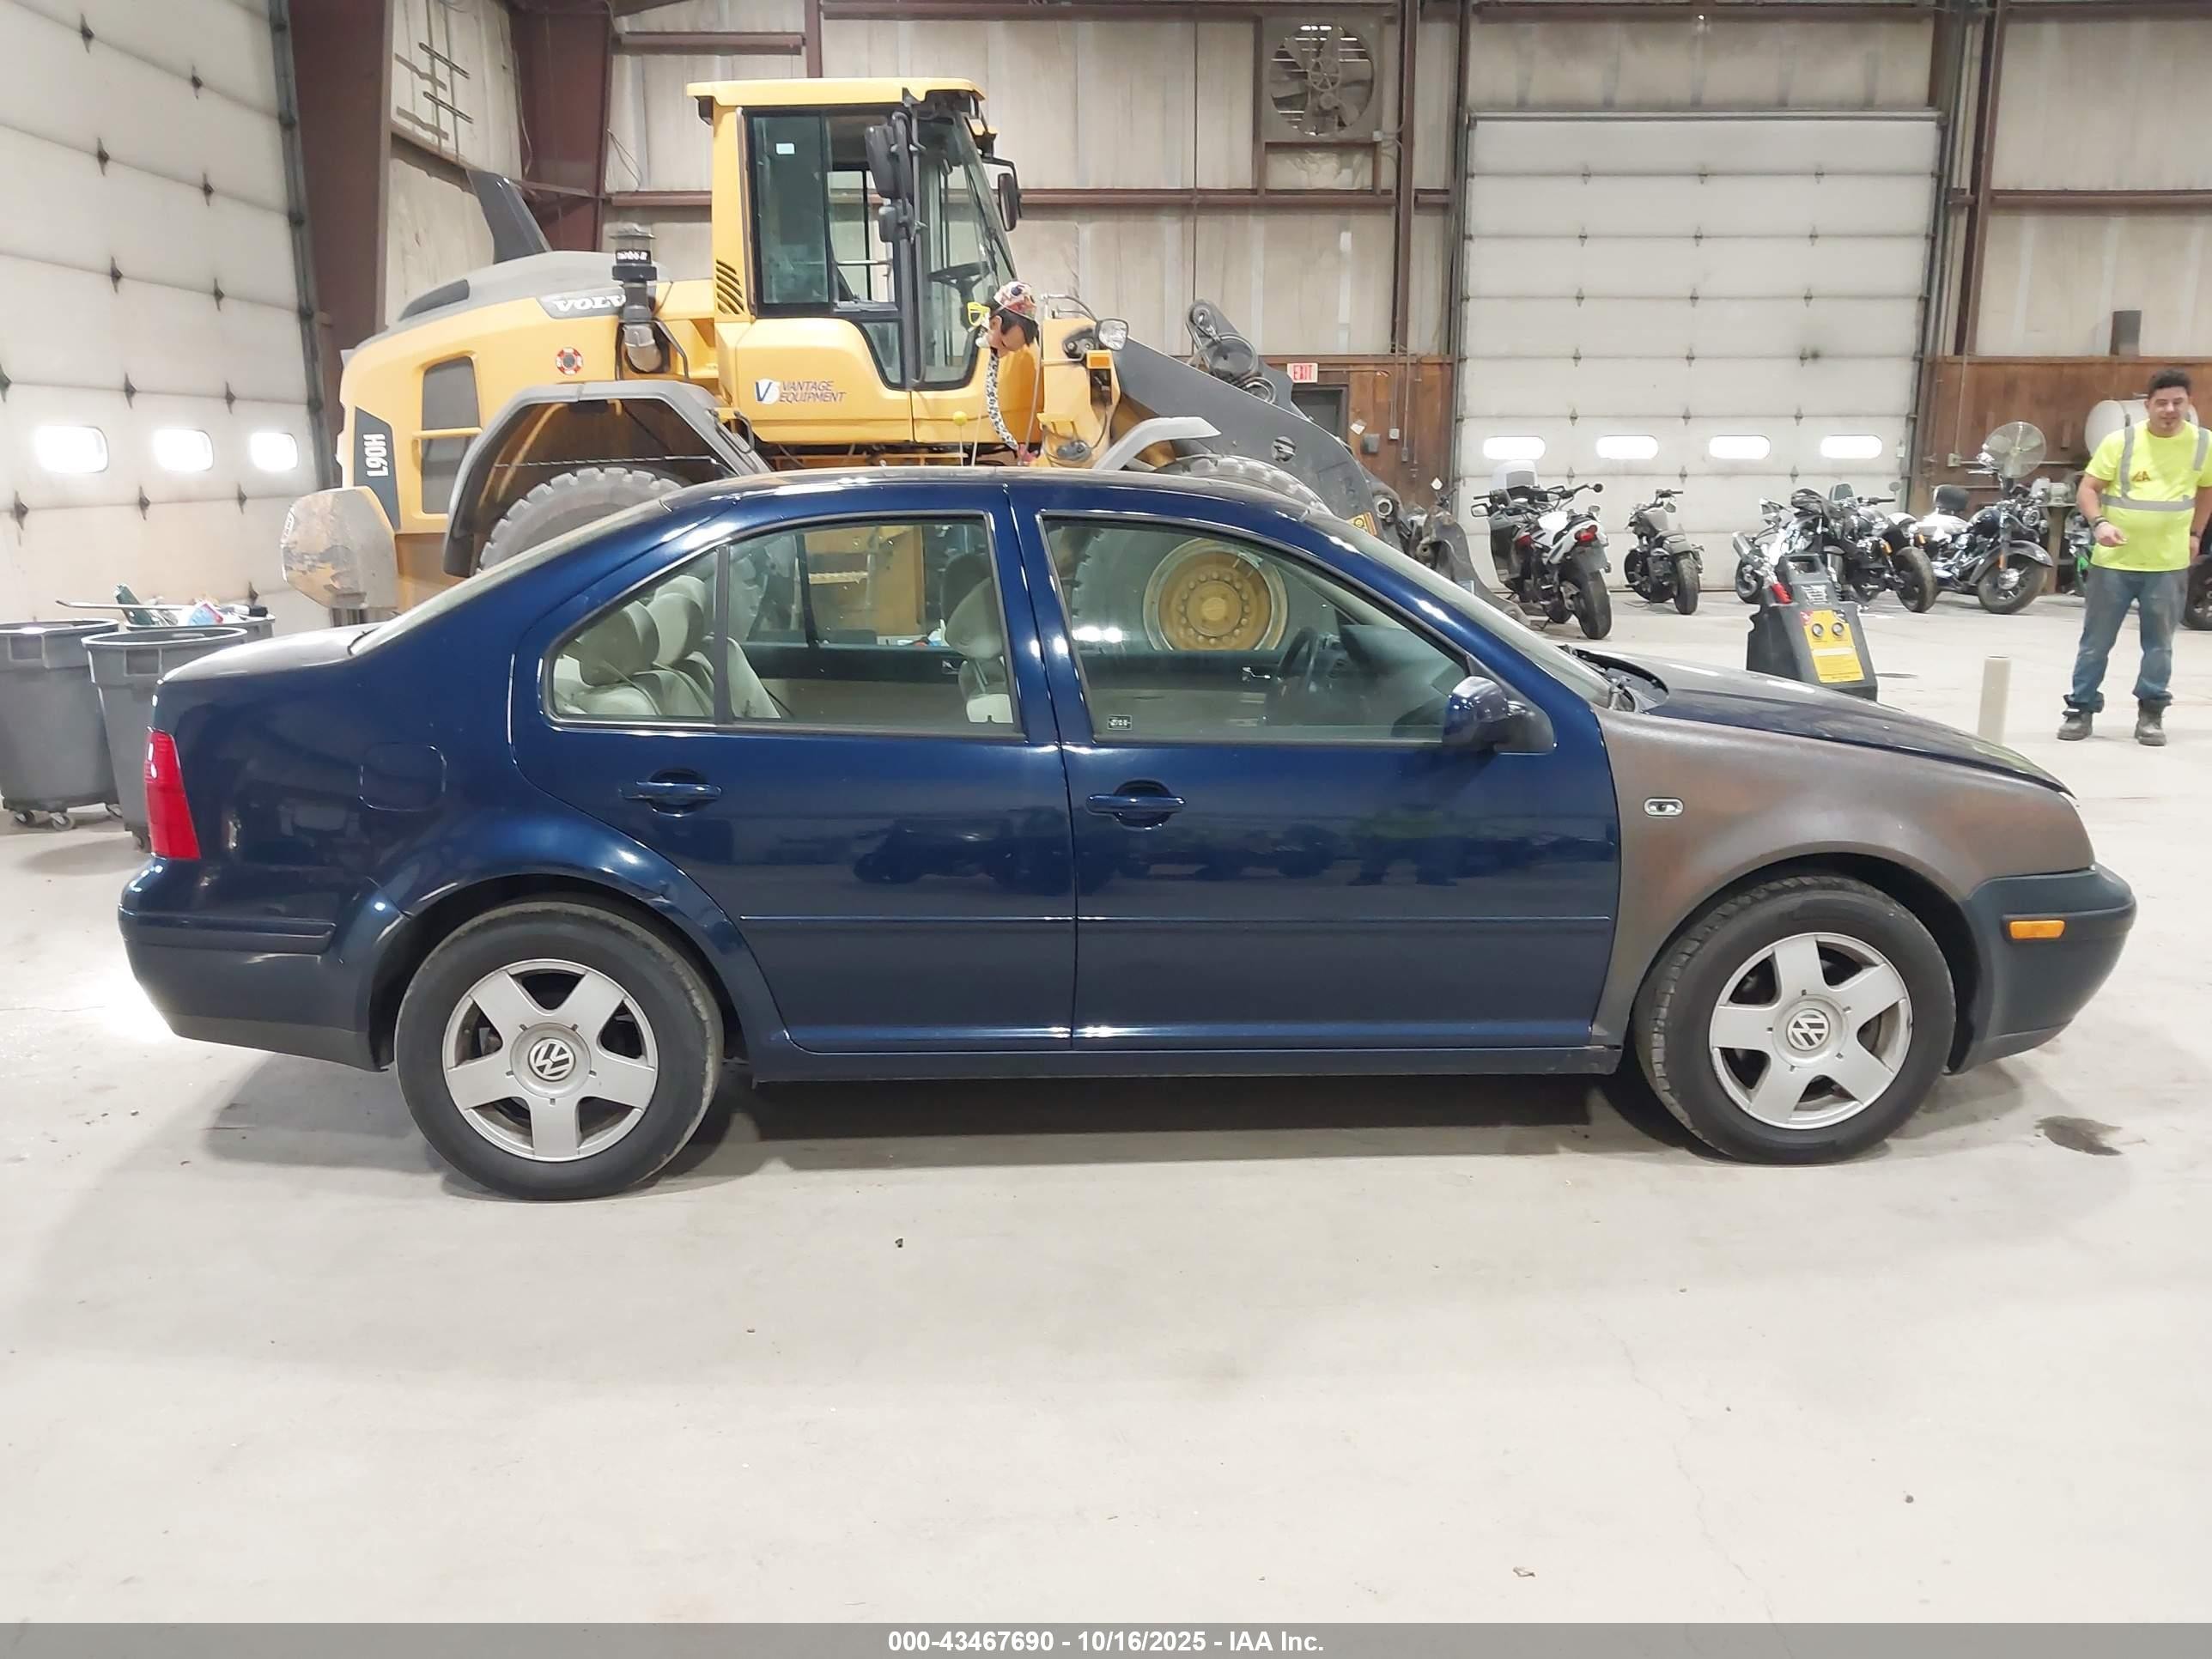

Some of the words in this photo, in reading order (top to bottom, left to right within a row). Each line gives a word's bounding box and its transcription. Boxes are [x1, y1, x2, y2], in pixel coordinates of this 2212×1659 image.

[553, 295, 627, 312] VOLV
[781, 380, 834, 392] VANTAGE
[779, 392, 847, 404] EQUIPMENT
[362, 433, 389, 477] L90H
